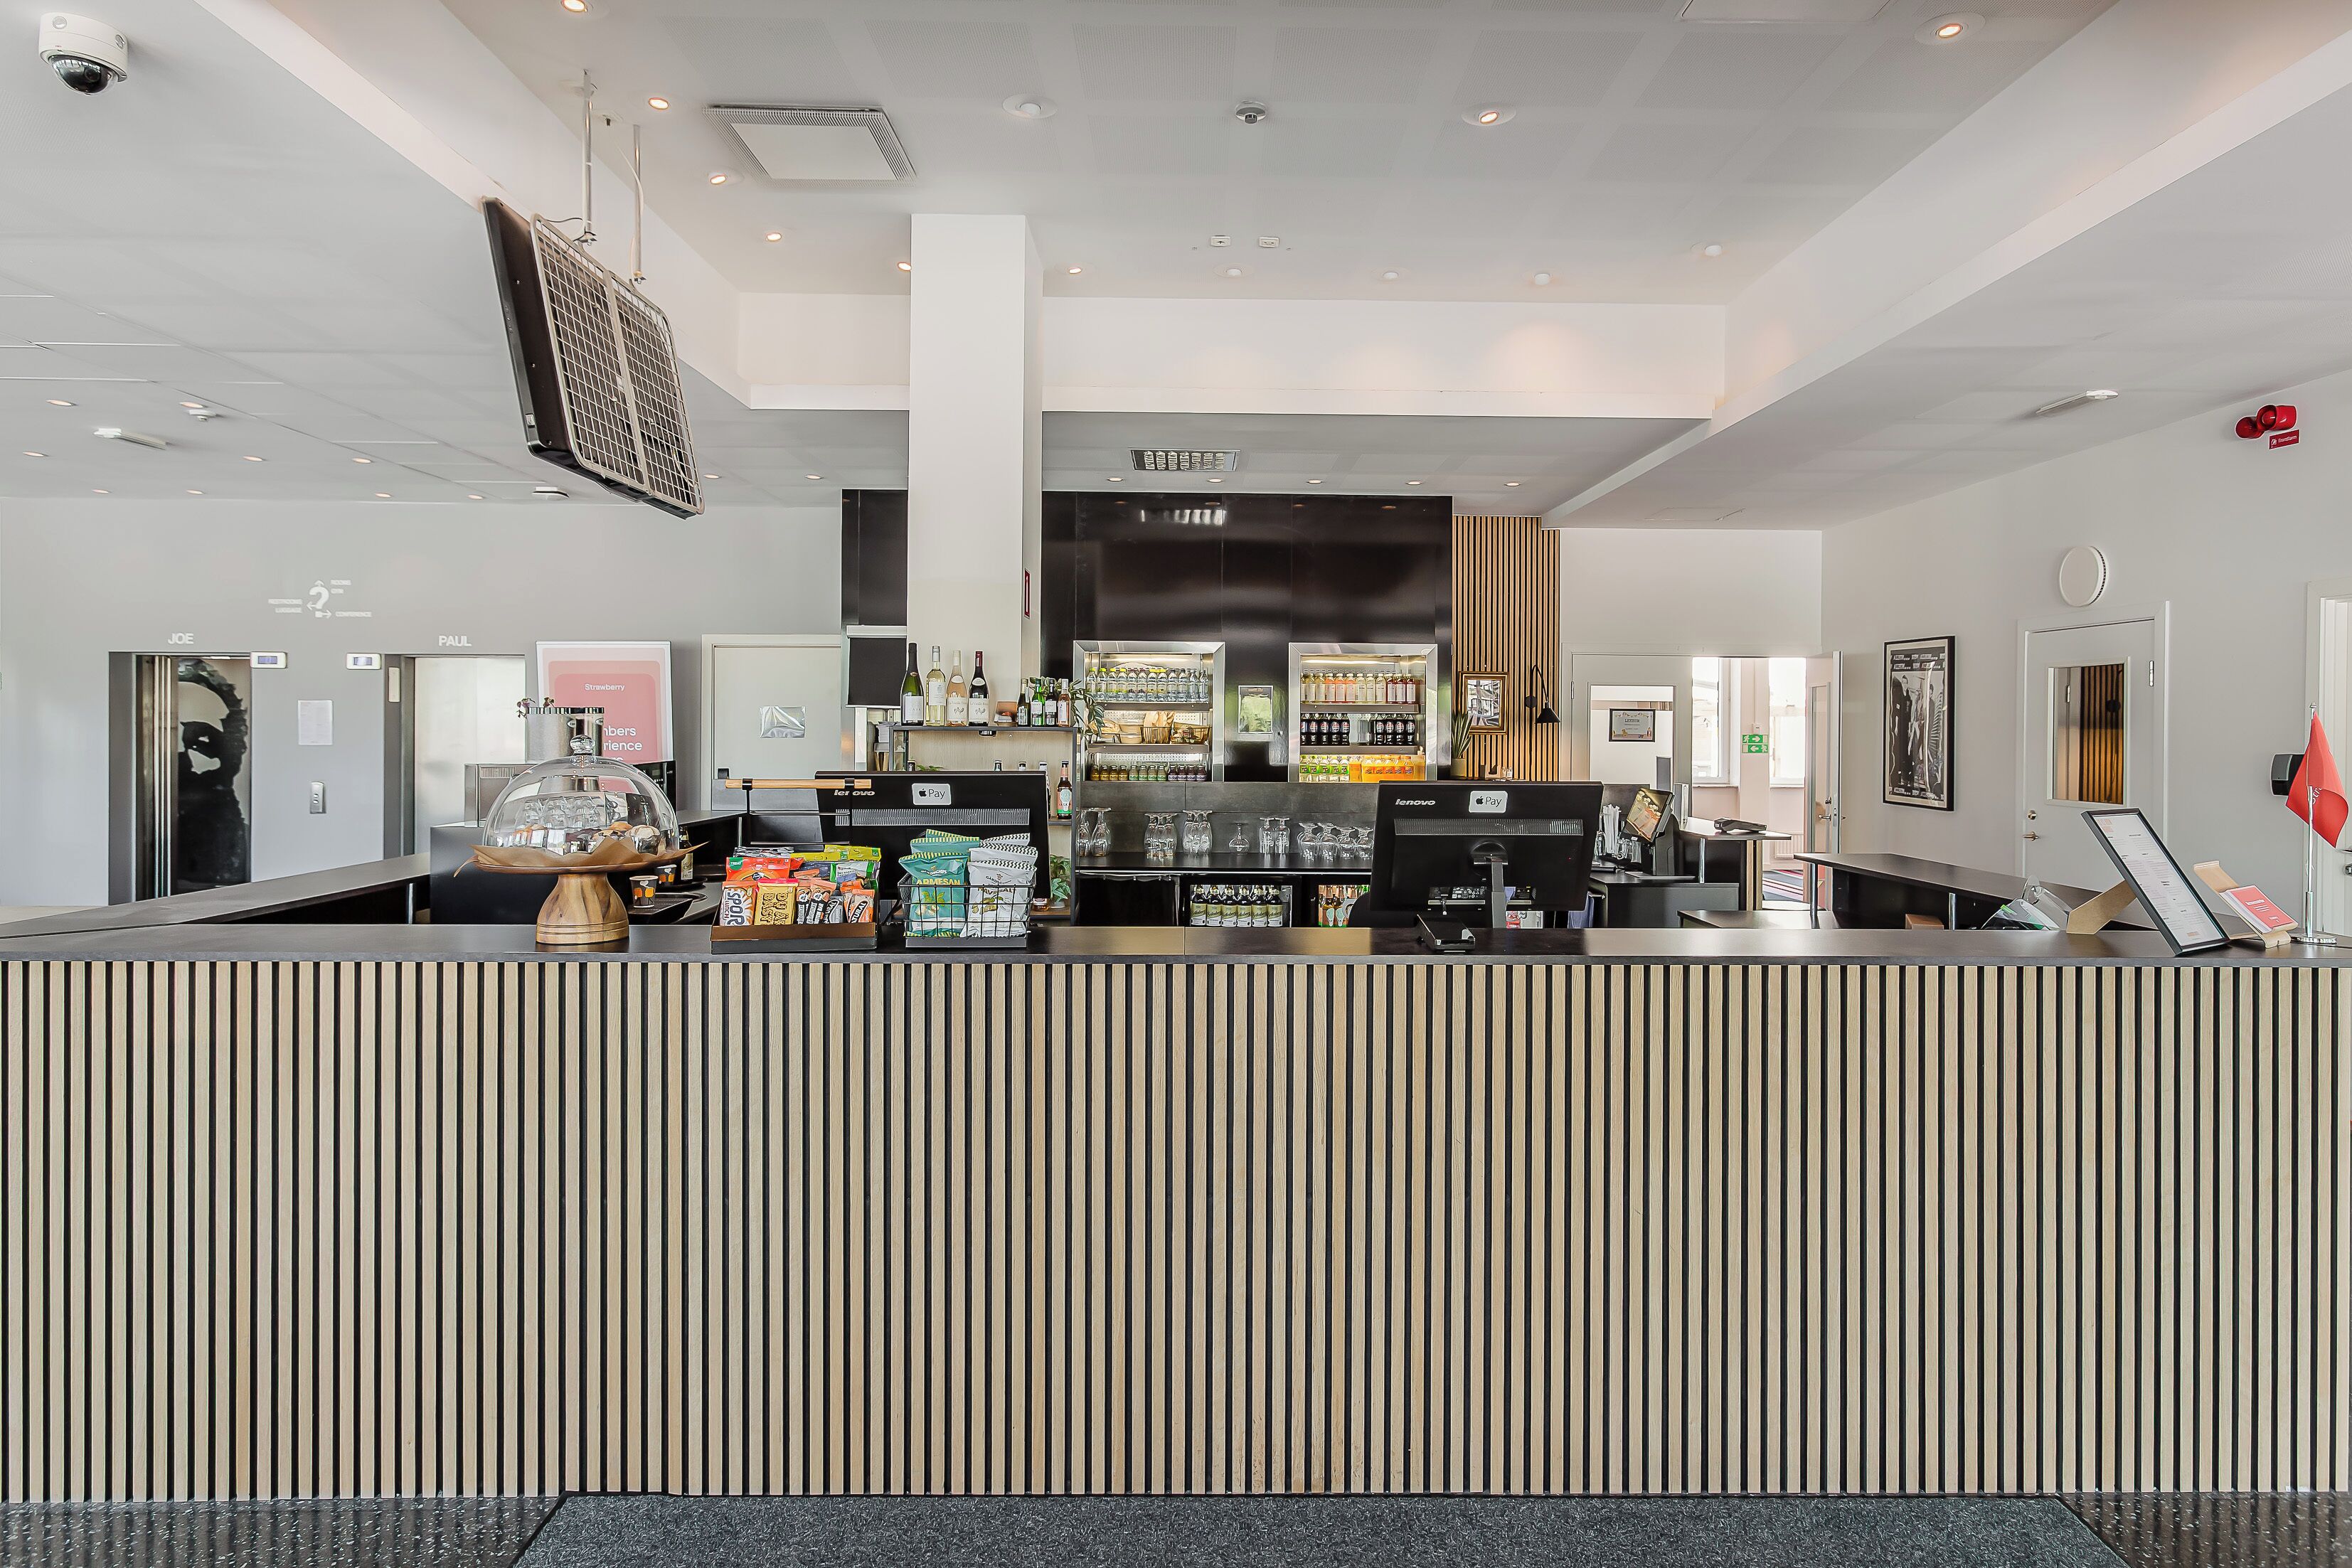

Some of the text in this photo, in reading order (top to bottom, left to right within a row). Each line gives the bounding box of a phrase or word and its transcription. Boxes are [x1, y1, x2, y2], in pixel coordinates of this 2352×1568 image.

[168, 633, 193, 645] JOE
[438, 636, 472, 646] PAUL
[929, 789, 945, 799] Pay
[1486, 796, 1502, 807] Pay
